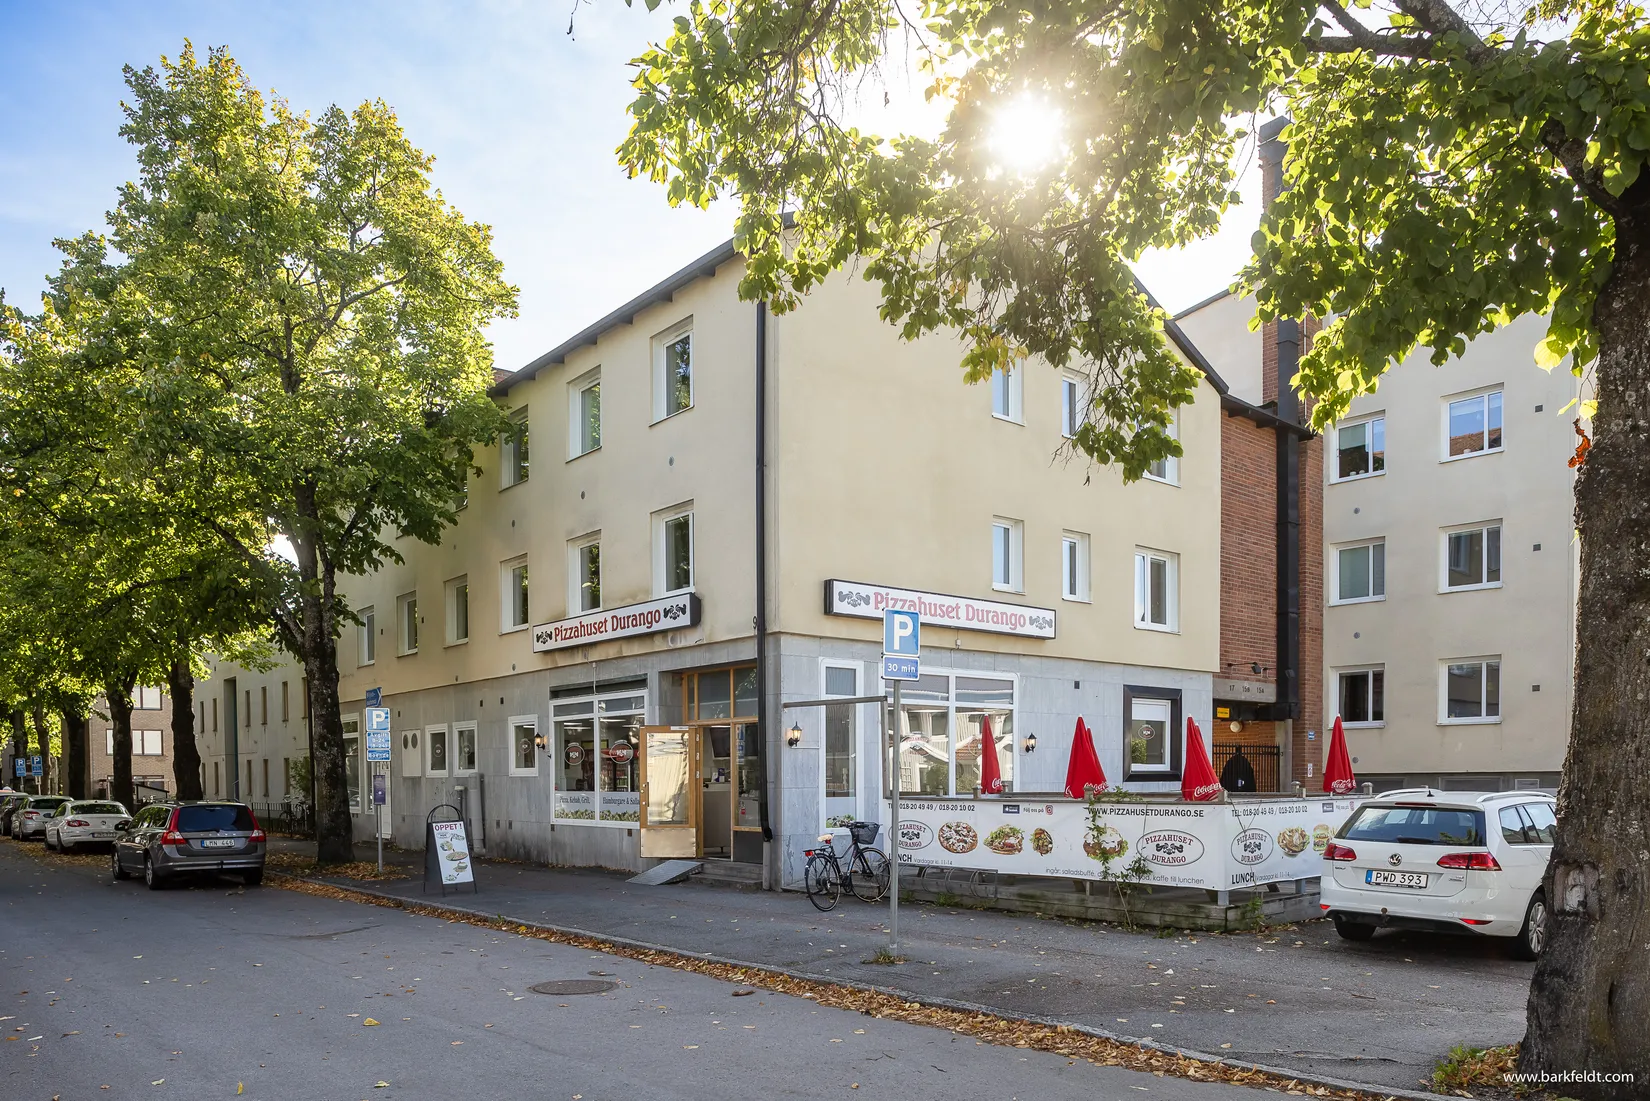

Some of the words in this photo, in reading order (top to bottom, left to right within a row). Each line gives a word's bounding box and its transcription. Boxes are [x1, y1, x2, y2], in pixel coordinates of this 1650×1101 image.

[873, 592, 960, 620] Pizzahuset
[965, 604, 1027, 630] Durango
[554, 618, 608, 642] Pizzahuset
[611, 609, 661, 632] Durango
[893, 613, 914, 650] P
[887, 663, 898, 672] 30
[901, 664, 916, 673] min
[1229, 684, 1235, 692] 17
[372, 710, 386, 729] P
[899, 802, 917, 810] 018-20
[926, 803, 933, 811] 49
[1242, 807, 1259, 816] 018-20
[1261, 807, 1267, 815] 49
[1268, 807, 1274, 815] 49
[1295, 805, 1301, 813] 10
[1302, 805, 1308, 813] 02
[898, 840, 922, 848] DURANGO
[1144, 834, 1194, 846] PIZZAHUSET
[1151, 853, 1187, 864] DURANGO
[1153, 874, 1169, 882] kaffe
[1178, 876, 1205, 885] lunchen
[1231, 871, 1255, 884] LUNCH
[1374, 872, 1396, 883] PWD
[1400, 873, 1422, 885] 393
